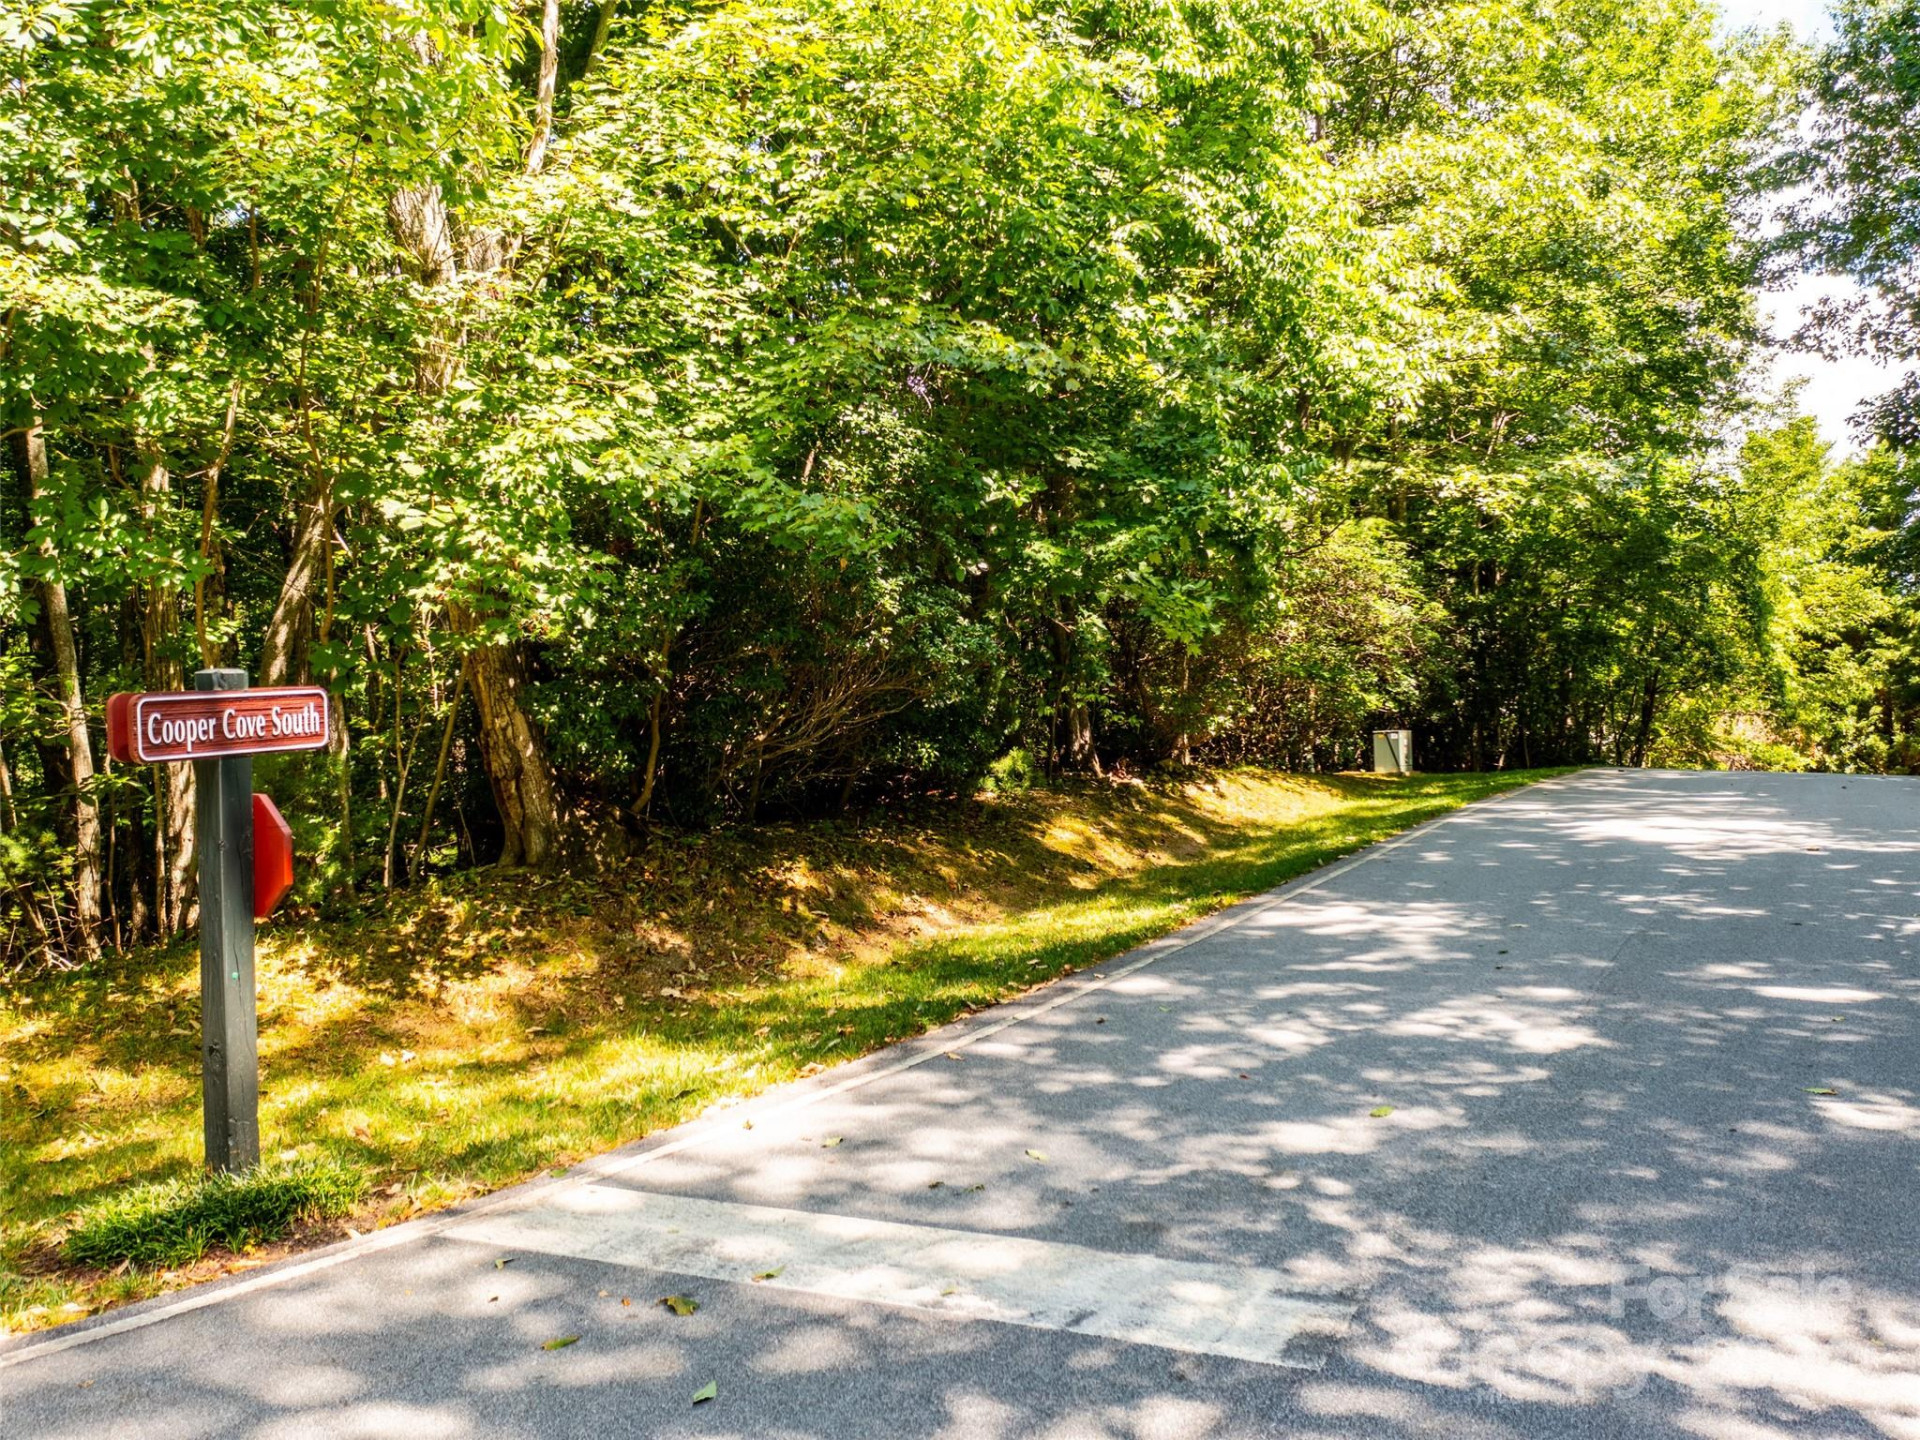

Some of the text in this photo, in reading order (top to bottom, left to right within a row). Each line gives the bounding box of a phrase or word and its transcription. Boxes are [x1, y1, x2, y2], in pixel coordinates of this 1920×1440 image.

[147, 702, 320, 752] Cooper Cove South
